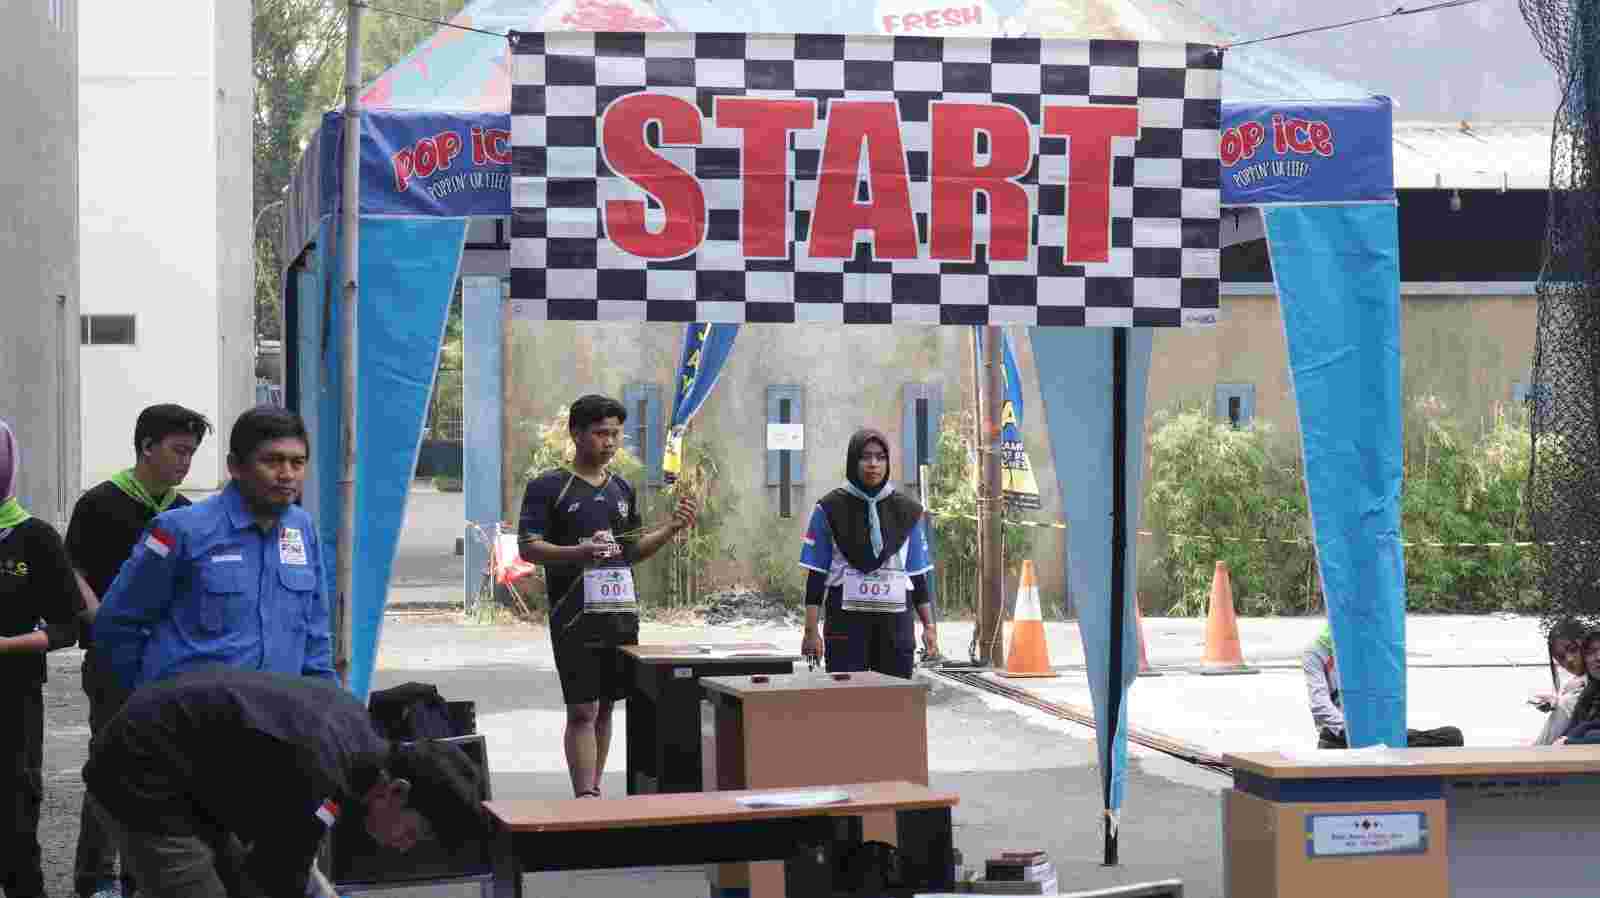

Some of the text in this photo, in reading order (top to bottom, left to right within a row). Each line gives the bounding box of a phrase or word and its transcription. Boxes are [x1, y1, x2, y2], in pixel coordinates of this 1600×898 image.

[883, 4, 983, 33] FRESH
[1219, 120, 1265, 167] OP
[601, 90, 1141, 264] START
[859, 583, 891, 596] 007
